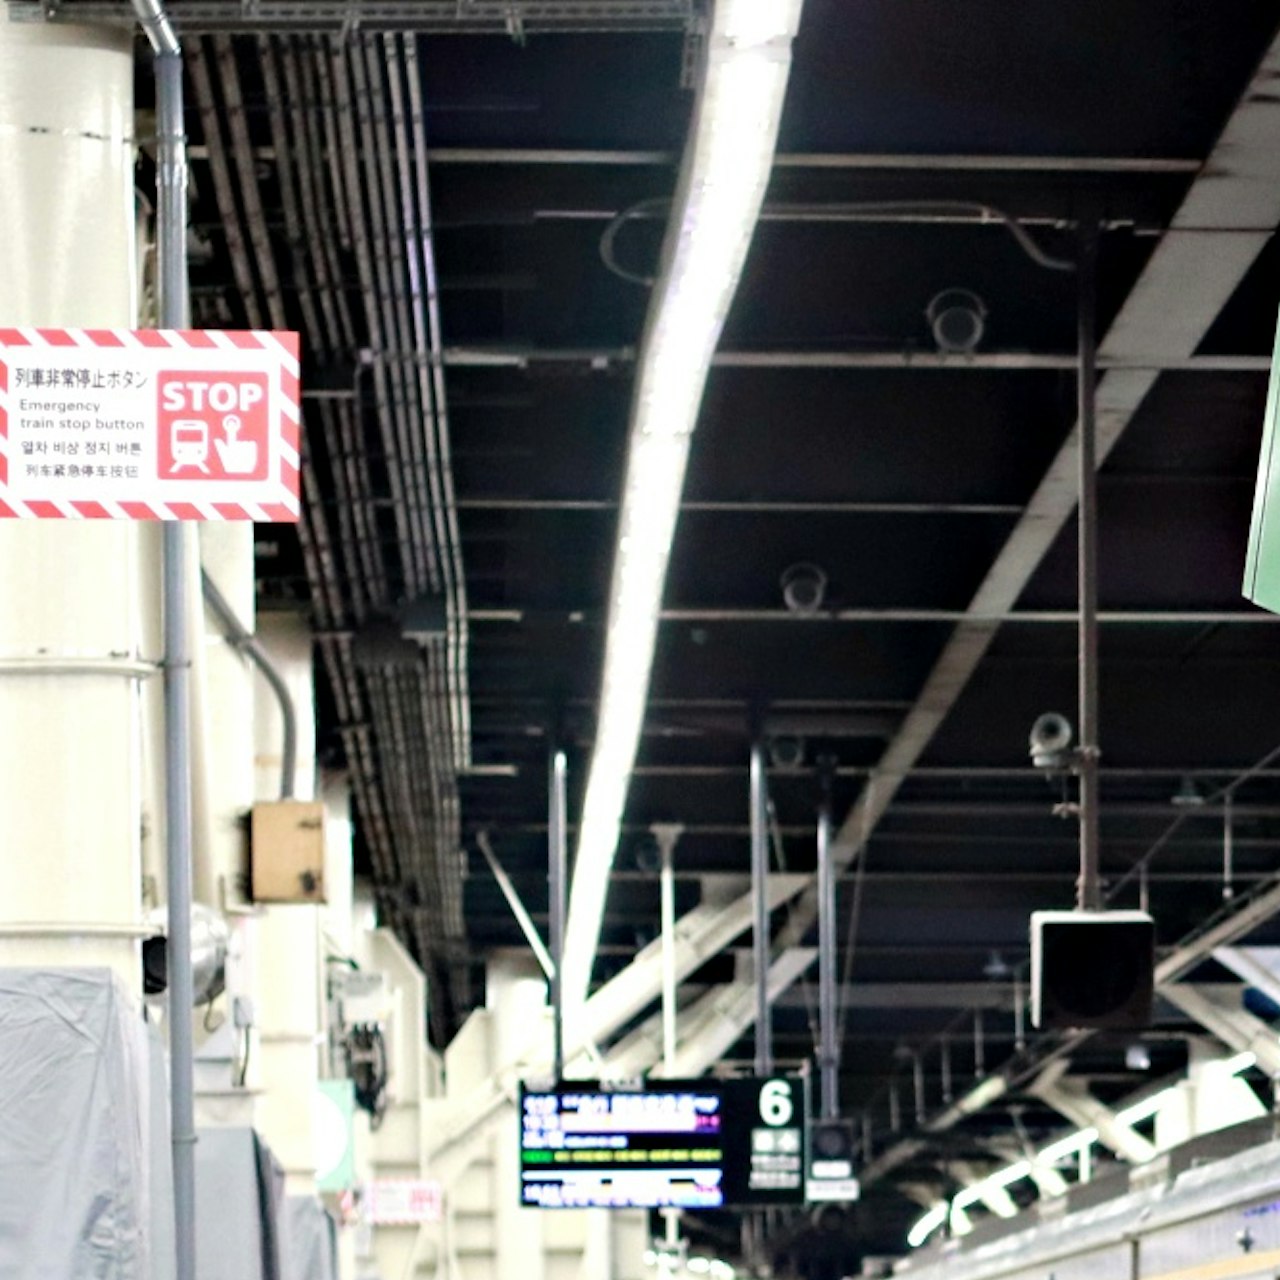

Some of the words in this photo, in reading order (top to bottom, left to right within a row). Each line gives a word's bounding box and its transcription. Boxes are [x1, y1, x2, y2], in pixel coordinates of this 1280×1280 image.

[15, 367, 148, 389] 列車非常停止ボタン
[19, 398, 101, 413] Emergency
[162, 381, 263, 412] STOP
[20, 416, 55, 429] train
[59, 418, 91, 432] stop
[95, 418, 145, 430] button
[759, 1079, 792, 1126] 6
